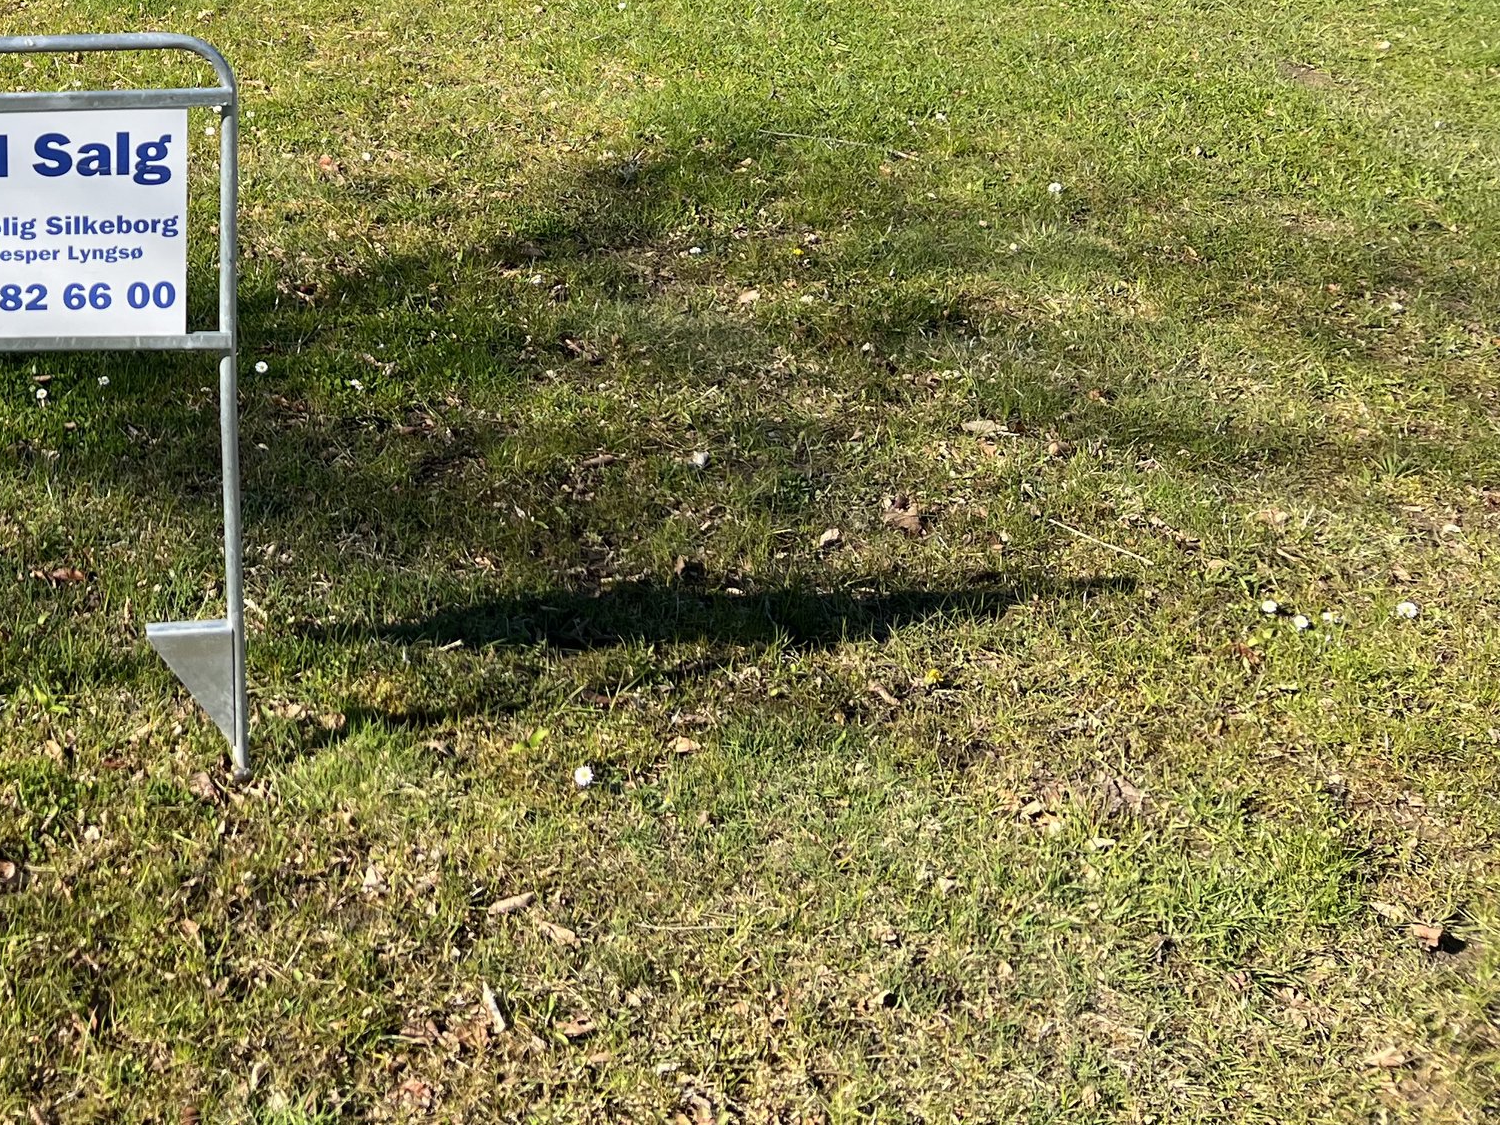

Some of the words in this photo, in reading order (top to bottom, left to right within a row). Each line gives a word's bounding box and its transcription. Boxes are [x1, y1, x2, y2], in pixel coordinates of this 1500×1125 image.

[32, 131, 172, 186] Salg
[45, 214, 179, 238] Silkeborg
[67, 245, 144, 264] Lyngsø
[62, 282, 113, 310] 66
[126, 281, 177, 309] 00
